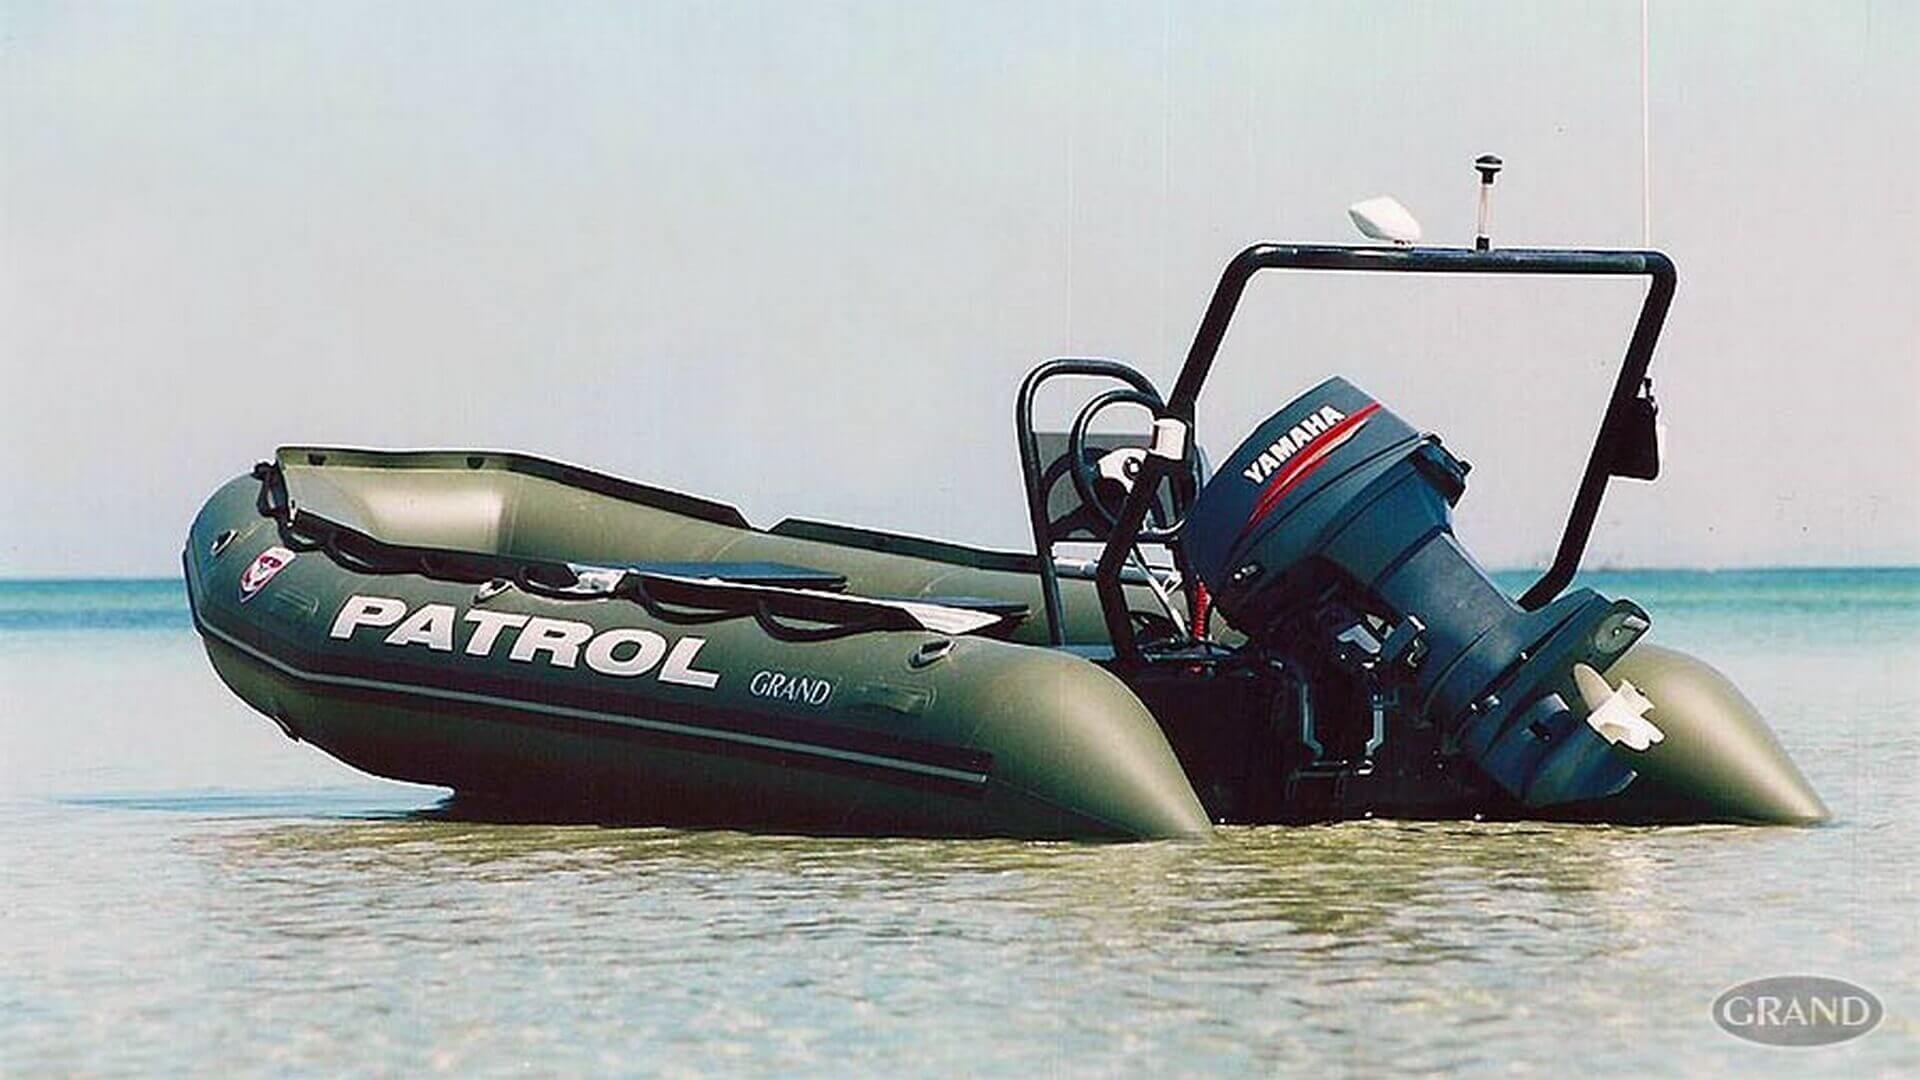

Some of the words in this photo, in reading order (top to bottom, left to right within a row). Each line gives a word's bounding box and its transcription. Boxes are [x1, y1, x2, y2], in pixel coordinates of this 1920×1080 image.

[1243, 405, 1346, 484] YAMAHA
[330, 595, 720, 688] PATROL
[749, 671, 832, 705] GRAND
